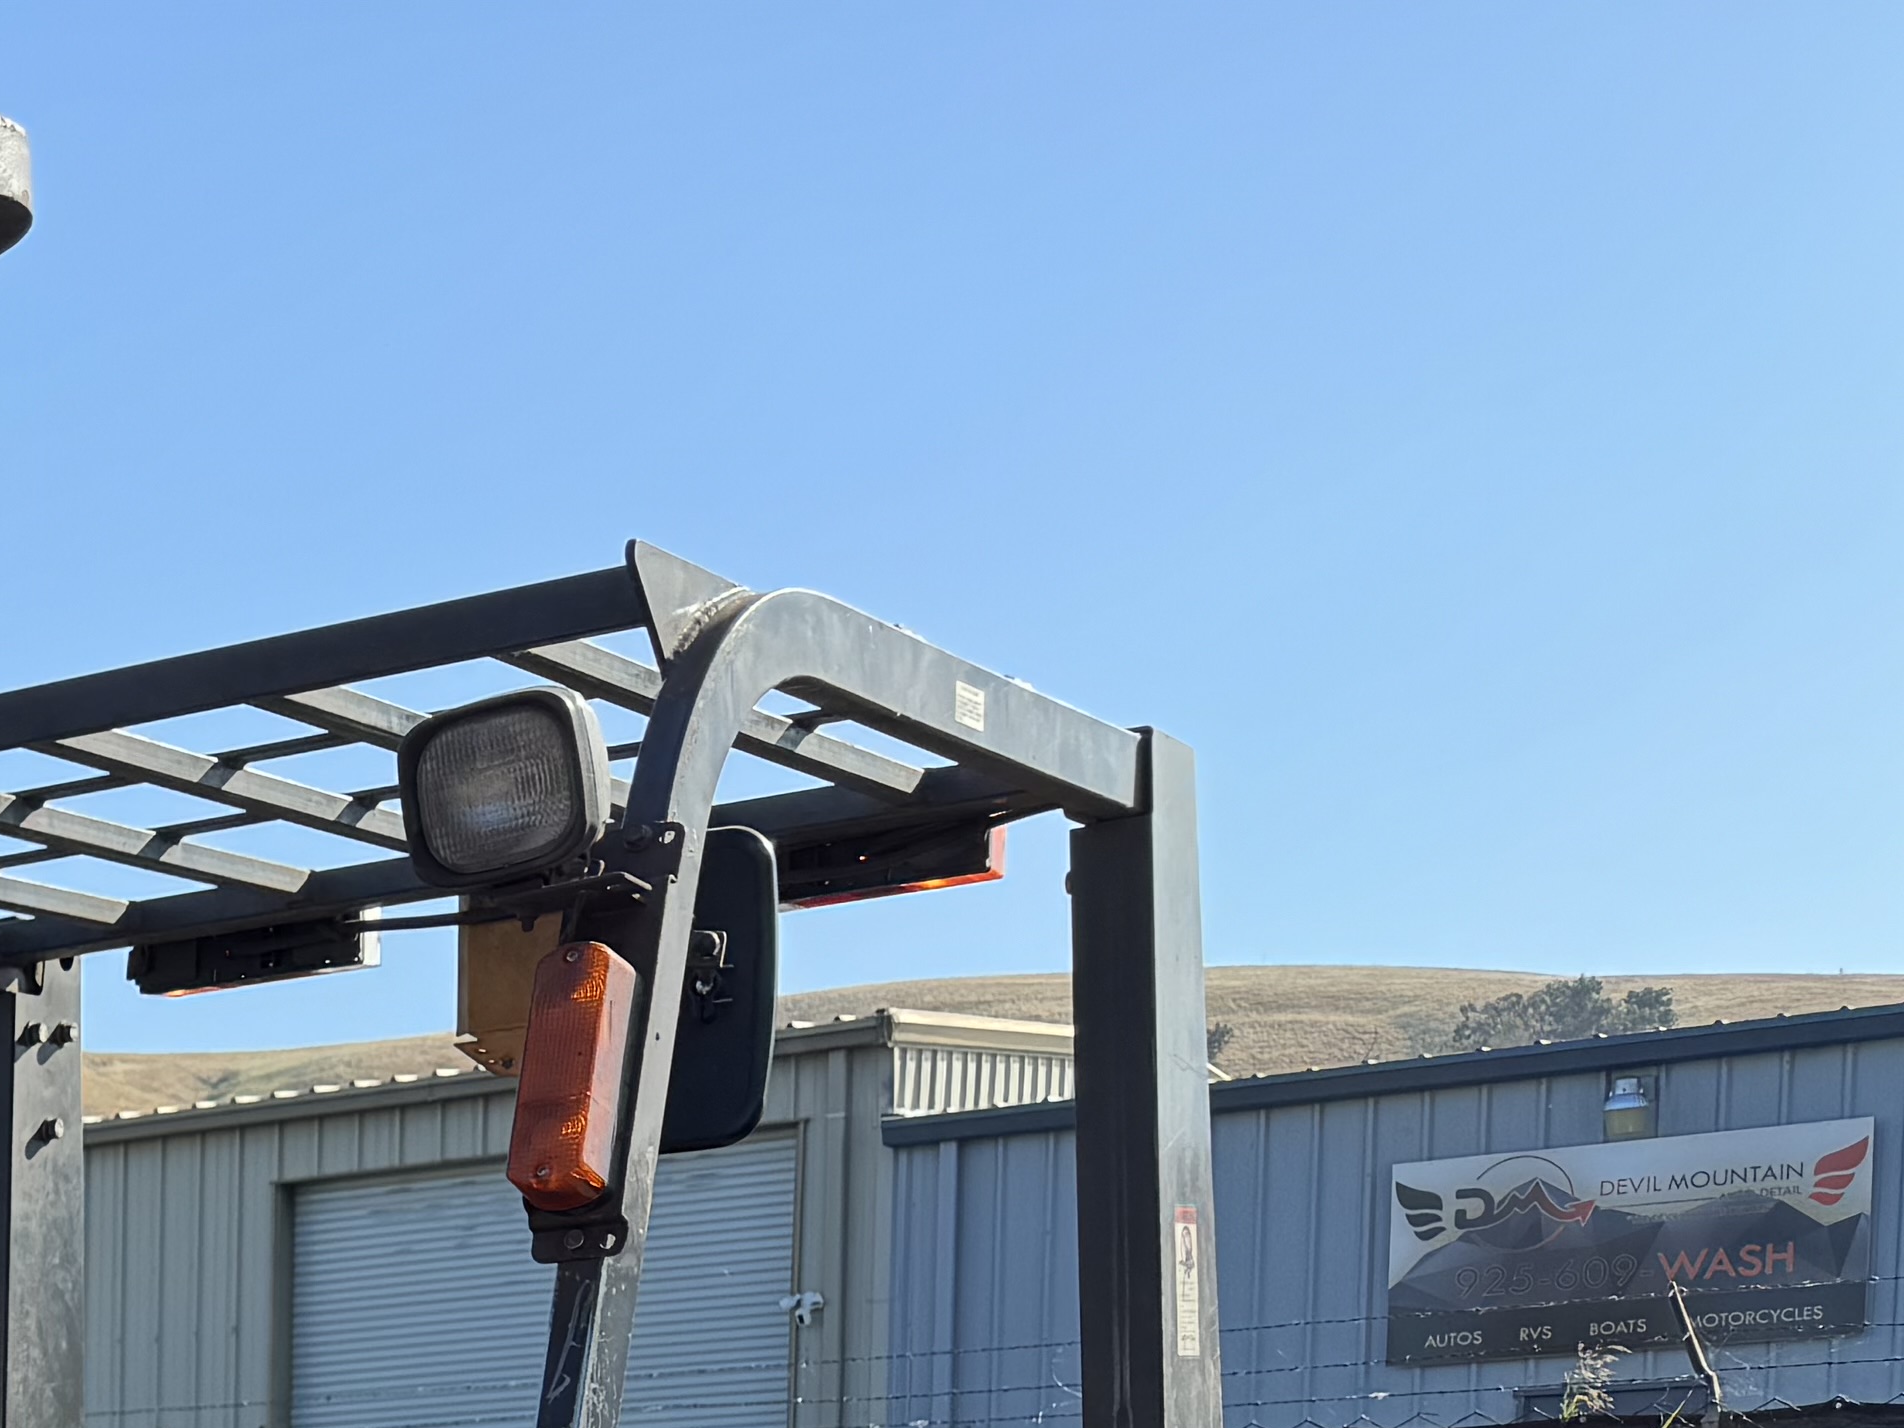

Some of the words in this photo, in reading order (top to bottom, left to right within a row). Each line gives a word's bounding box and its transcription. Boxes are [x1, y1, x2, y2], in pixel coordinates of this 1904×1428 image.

[1600, 1176, 1661, 1197] DEVIL
[1668, 1162, 1804, 1191] MOUNTAIN
[1424, 1331, 1483, 1348] AUTOS
[1519, 1326, 1552, 1341] RVS
[1589, 1319, 1647, 1336] BOATS
[1688, 1306, 1824, 1329] MOTORCYCLES
